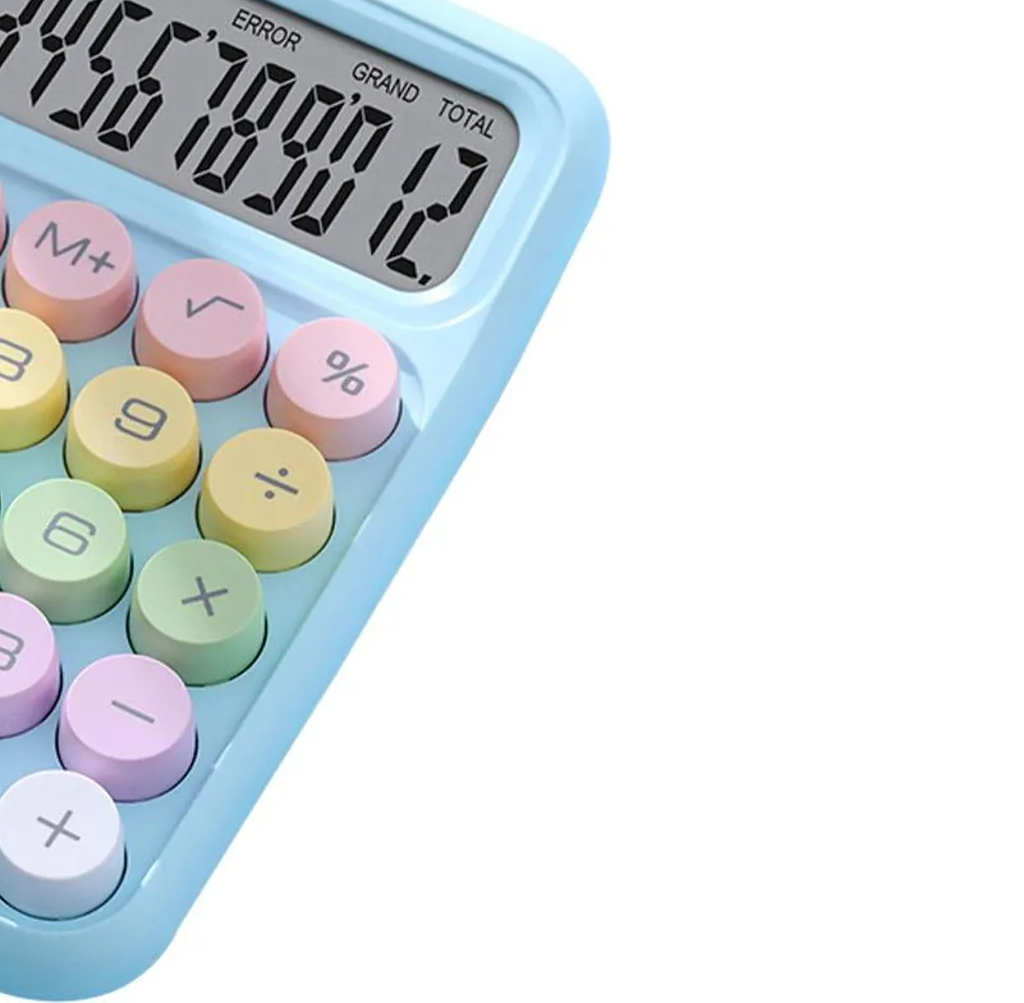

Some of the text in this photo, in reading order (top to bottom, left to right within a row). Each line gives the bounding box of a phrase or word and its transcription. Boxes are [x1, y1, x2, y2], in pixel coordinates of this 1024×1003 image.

[231, 9, 303, 53] ERROR
[351, 62, 421, 106] GRAND
[438, 98, 496, 141] TOTAL
[33, 220, 117, 276] M+
[113, 397, 169, 442] 9
[42, 511, 97, 557] 6
